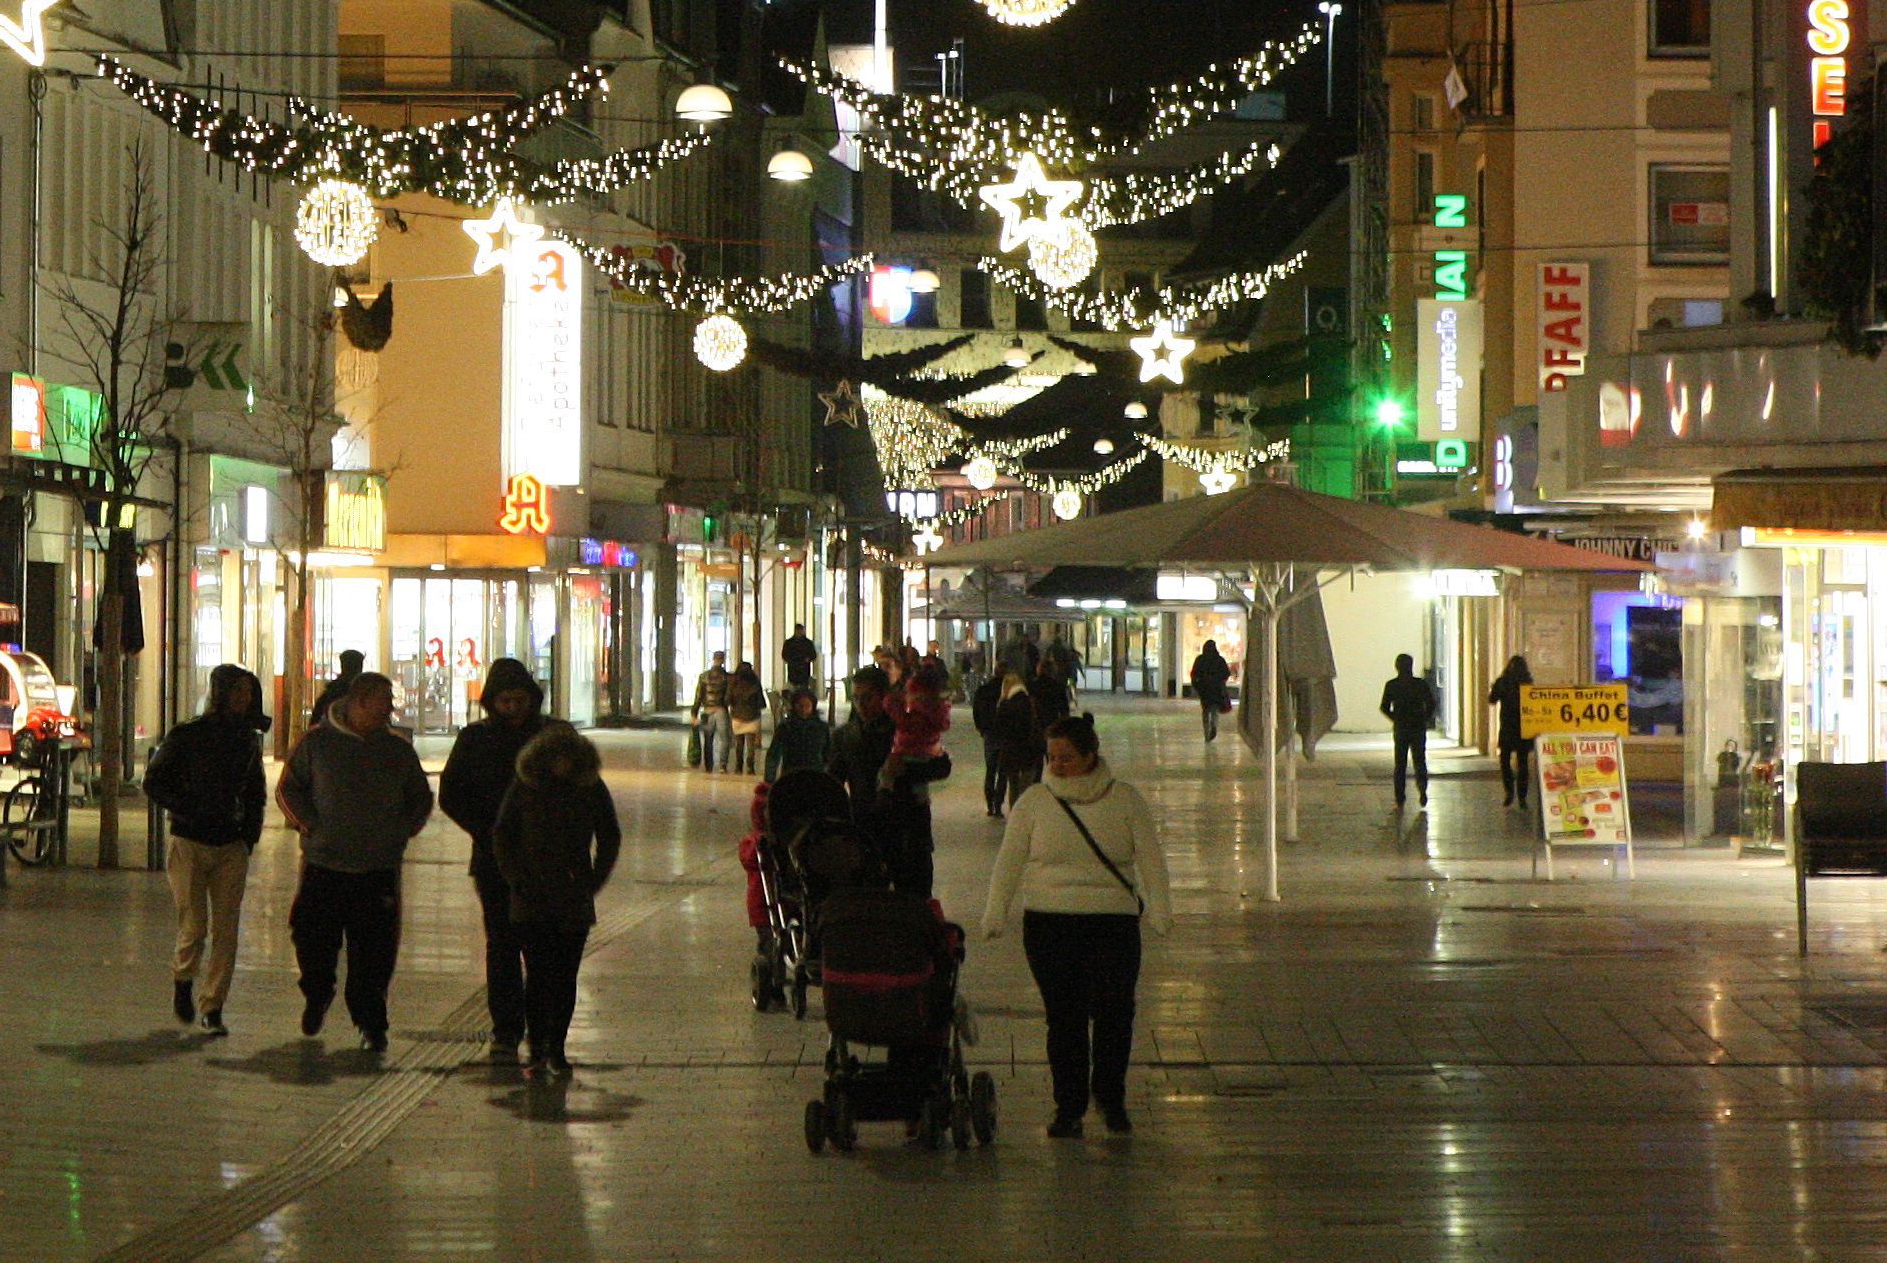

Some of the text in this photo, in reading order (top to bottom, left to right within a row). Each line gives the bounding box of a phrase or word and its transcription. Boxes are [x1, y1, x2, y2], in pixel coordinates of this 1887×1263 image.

[1436, 306, 1465, 432] unitymedia
[1529, 691, 1618, 700] China Buffet
[1580, 742, 1597, 754] CAN
